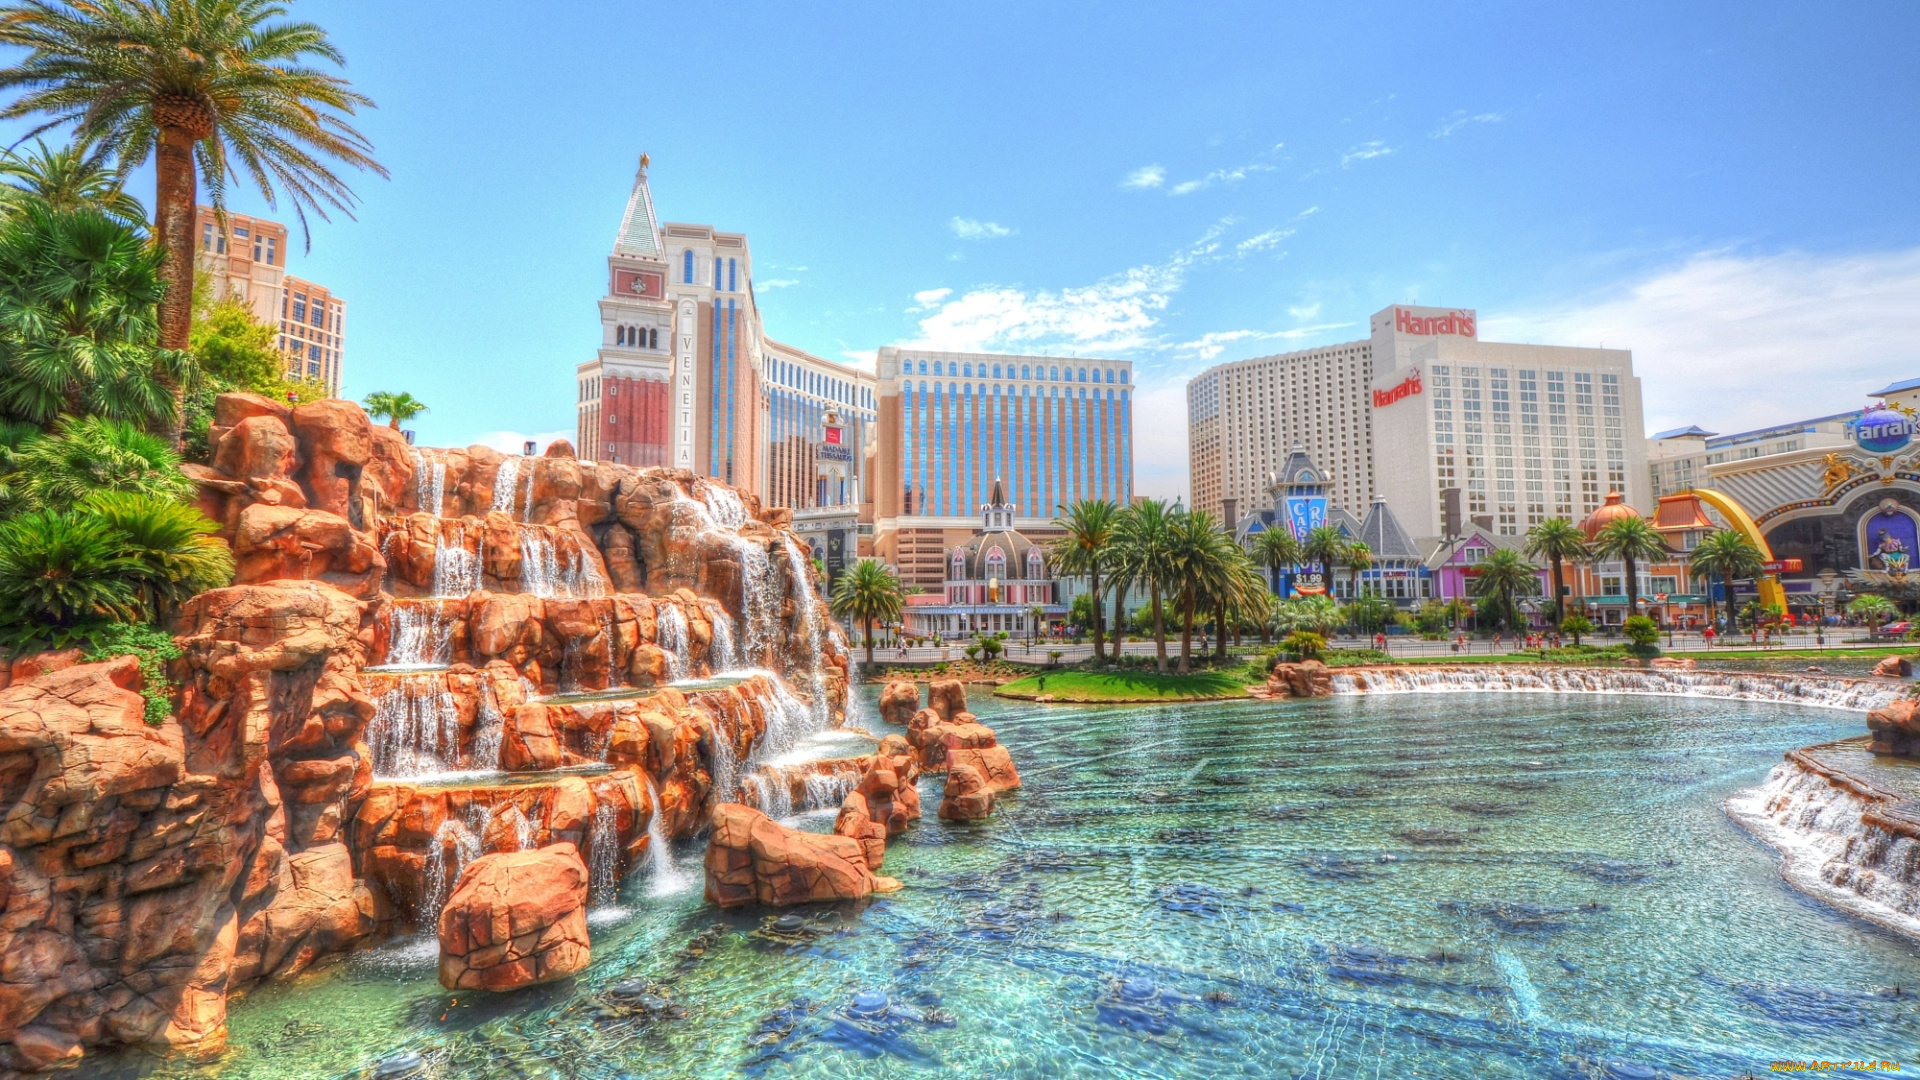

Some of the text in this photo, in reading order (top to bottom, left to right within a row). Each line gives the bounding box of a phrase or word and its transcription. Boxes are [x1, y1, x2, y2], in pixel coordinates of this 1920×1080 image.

[1395, 307, 1475, 337] Harrah's
[681, 337, 692, 460] VENETIA
[1373, 377, 1422, 408] Harrah's
[1295, 574, 1322, 583] $1.99
